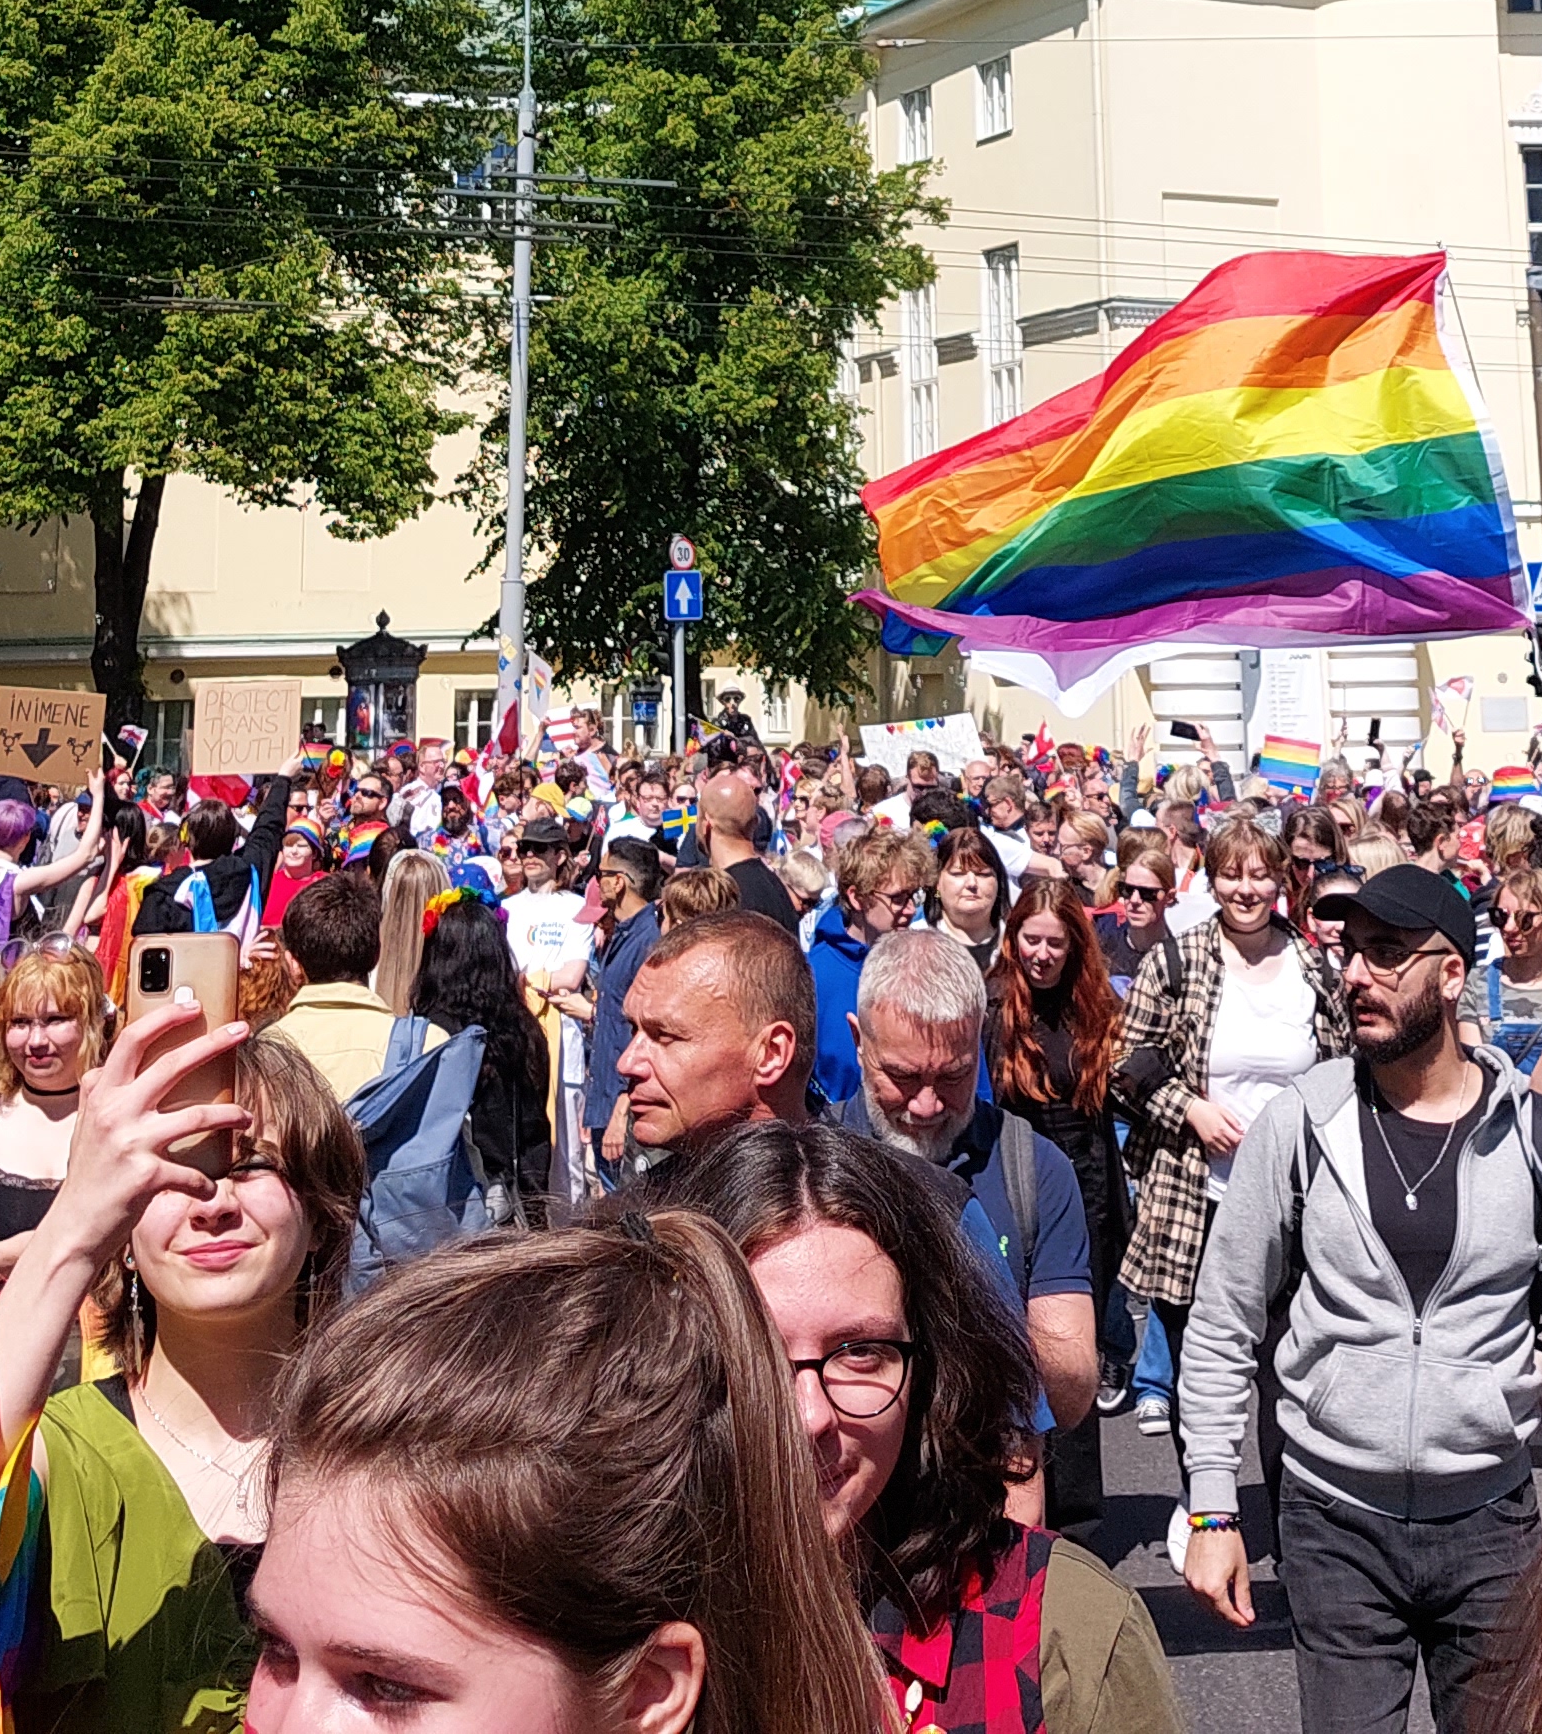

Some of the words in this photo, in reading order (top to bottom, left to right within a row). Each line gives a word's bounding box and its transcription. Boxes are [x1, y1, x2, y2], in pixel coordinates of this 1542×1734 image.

[677, 547, 690, 562] 30
[205, 689, 296, 716] PROTECT
[205, 714, 278, 735] TRANS
[203, 736, 285, 767] YOUTH
